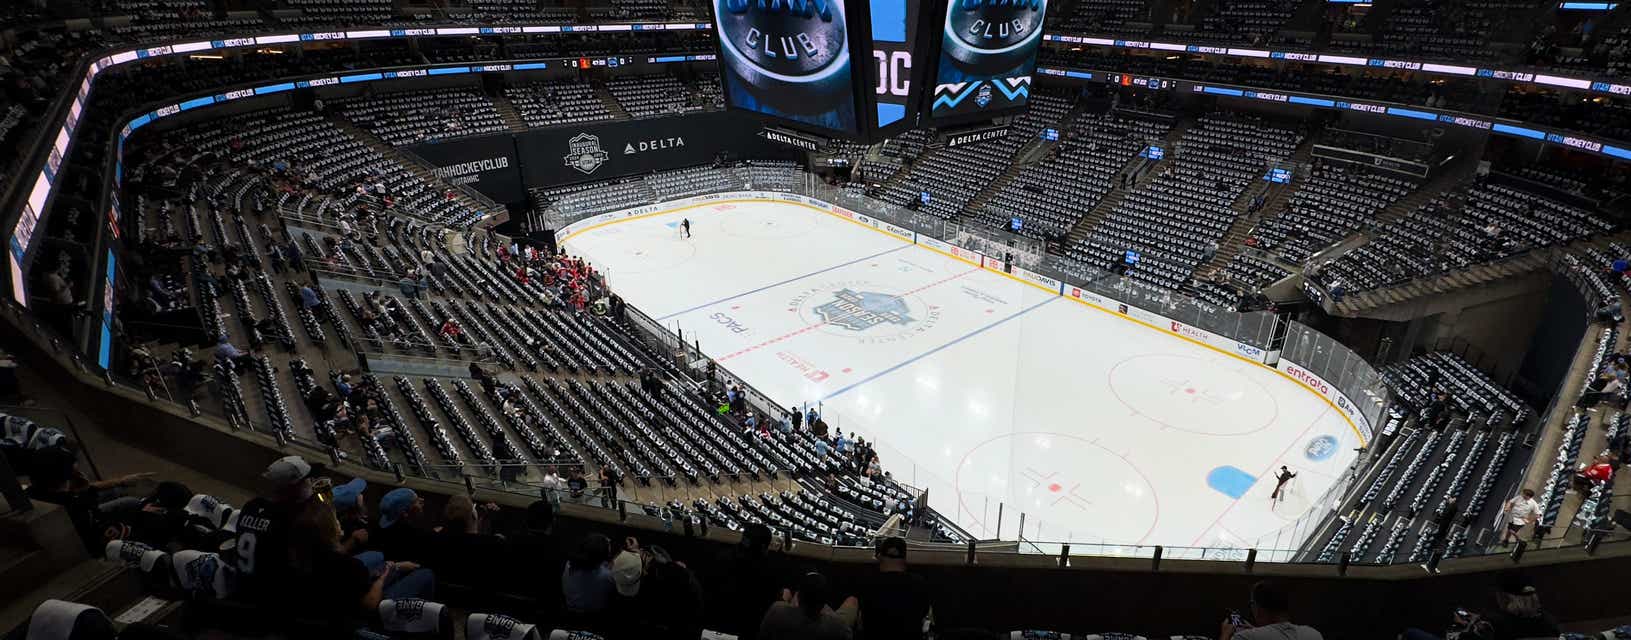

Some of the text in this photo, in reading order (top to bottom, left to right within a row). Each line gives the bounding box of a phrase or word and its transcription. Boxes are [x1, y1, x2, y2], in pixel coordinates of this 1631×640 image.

[970, 18, 1024, 38] CLUB
[746, 27, 818, 60] CLUB
[1368, 58, 1420, 70] UTAH HOCKEY CLUB
[1477, 69, 1534, 82] UTAH HOCKEY CLUB
[1592, 82, 1609, 92] UTAH
[1336, 101, 1386, 114] UTAH HOCKEY CLUB
[1440, 114, 1492, 130] UTAH HOCKEY CLUB
[639, 136, 684, 152] DELTA
[772, 132, 816, 150] DELTA CENTER
[958, 129, 1008, 144] DELTA CENTER
[1546, 133, 1601, 152] UTAH HOCKEY CLUB
[572, 146, 600, 156] SEASON
[432, 156, 509, 178] TAHHOCKEYCLUB
[634, 206, 658, 216] DELTA
[1182, 326, 1209, 340] HEALTH
[1286, 366, 1328, 394] entrata
[237, 532, 257, 576] 9
[396, 599, 424, 609] GAME
[486, 614, 514, 631] GAME
